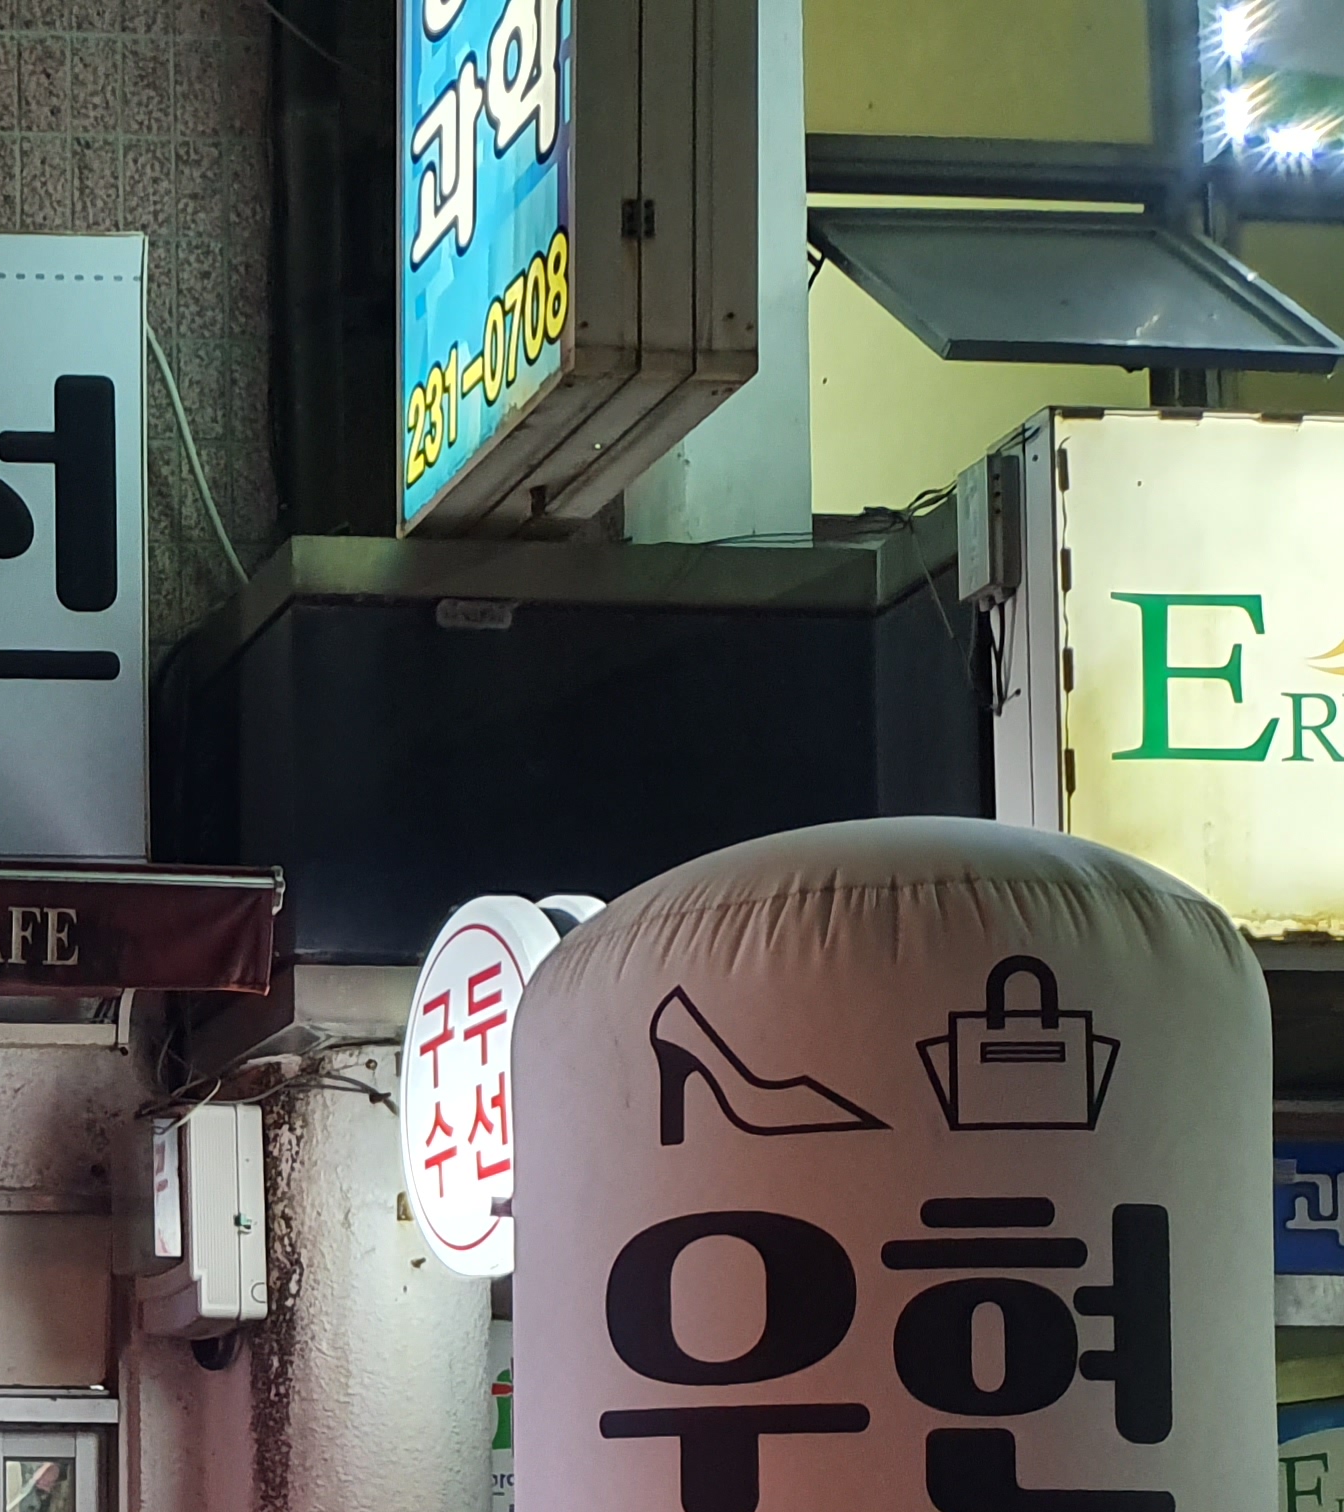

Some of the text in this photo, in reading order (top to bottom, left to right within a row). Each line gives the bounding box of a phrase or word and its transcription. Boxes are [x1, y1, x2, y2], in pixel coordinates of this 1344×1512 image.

[405, 227, 569, 488] 231-0708
[419, 961, 508, 1089] 구두
[425, 1071, 511, 1198] 수선
